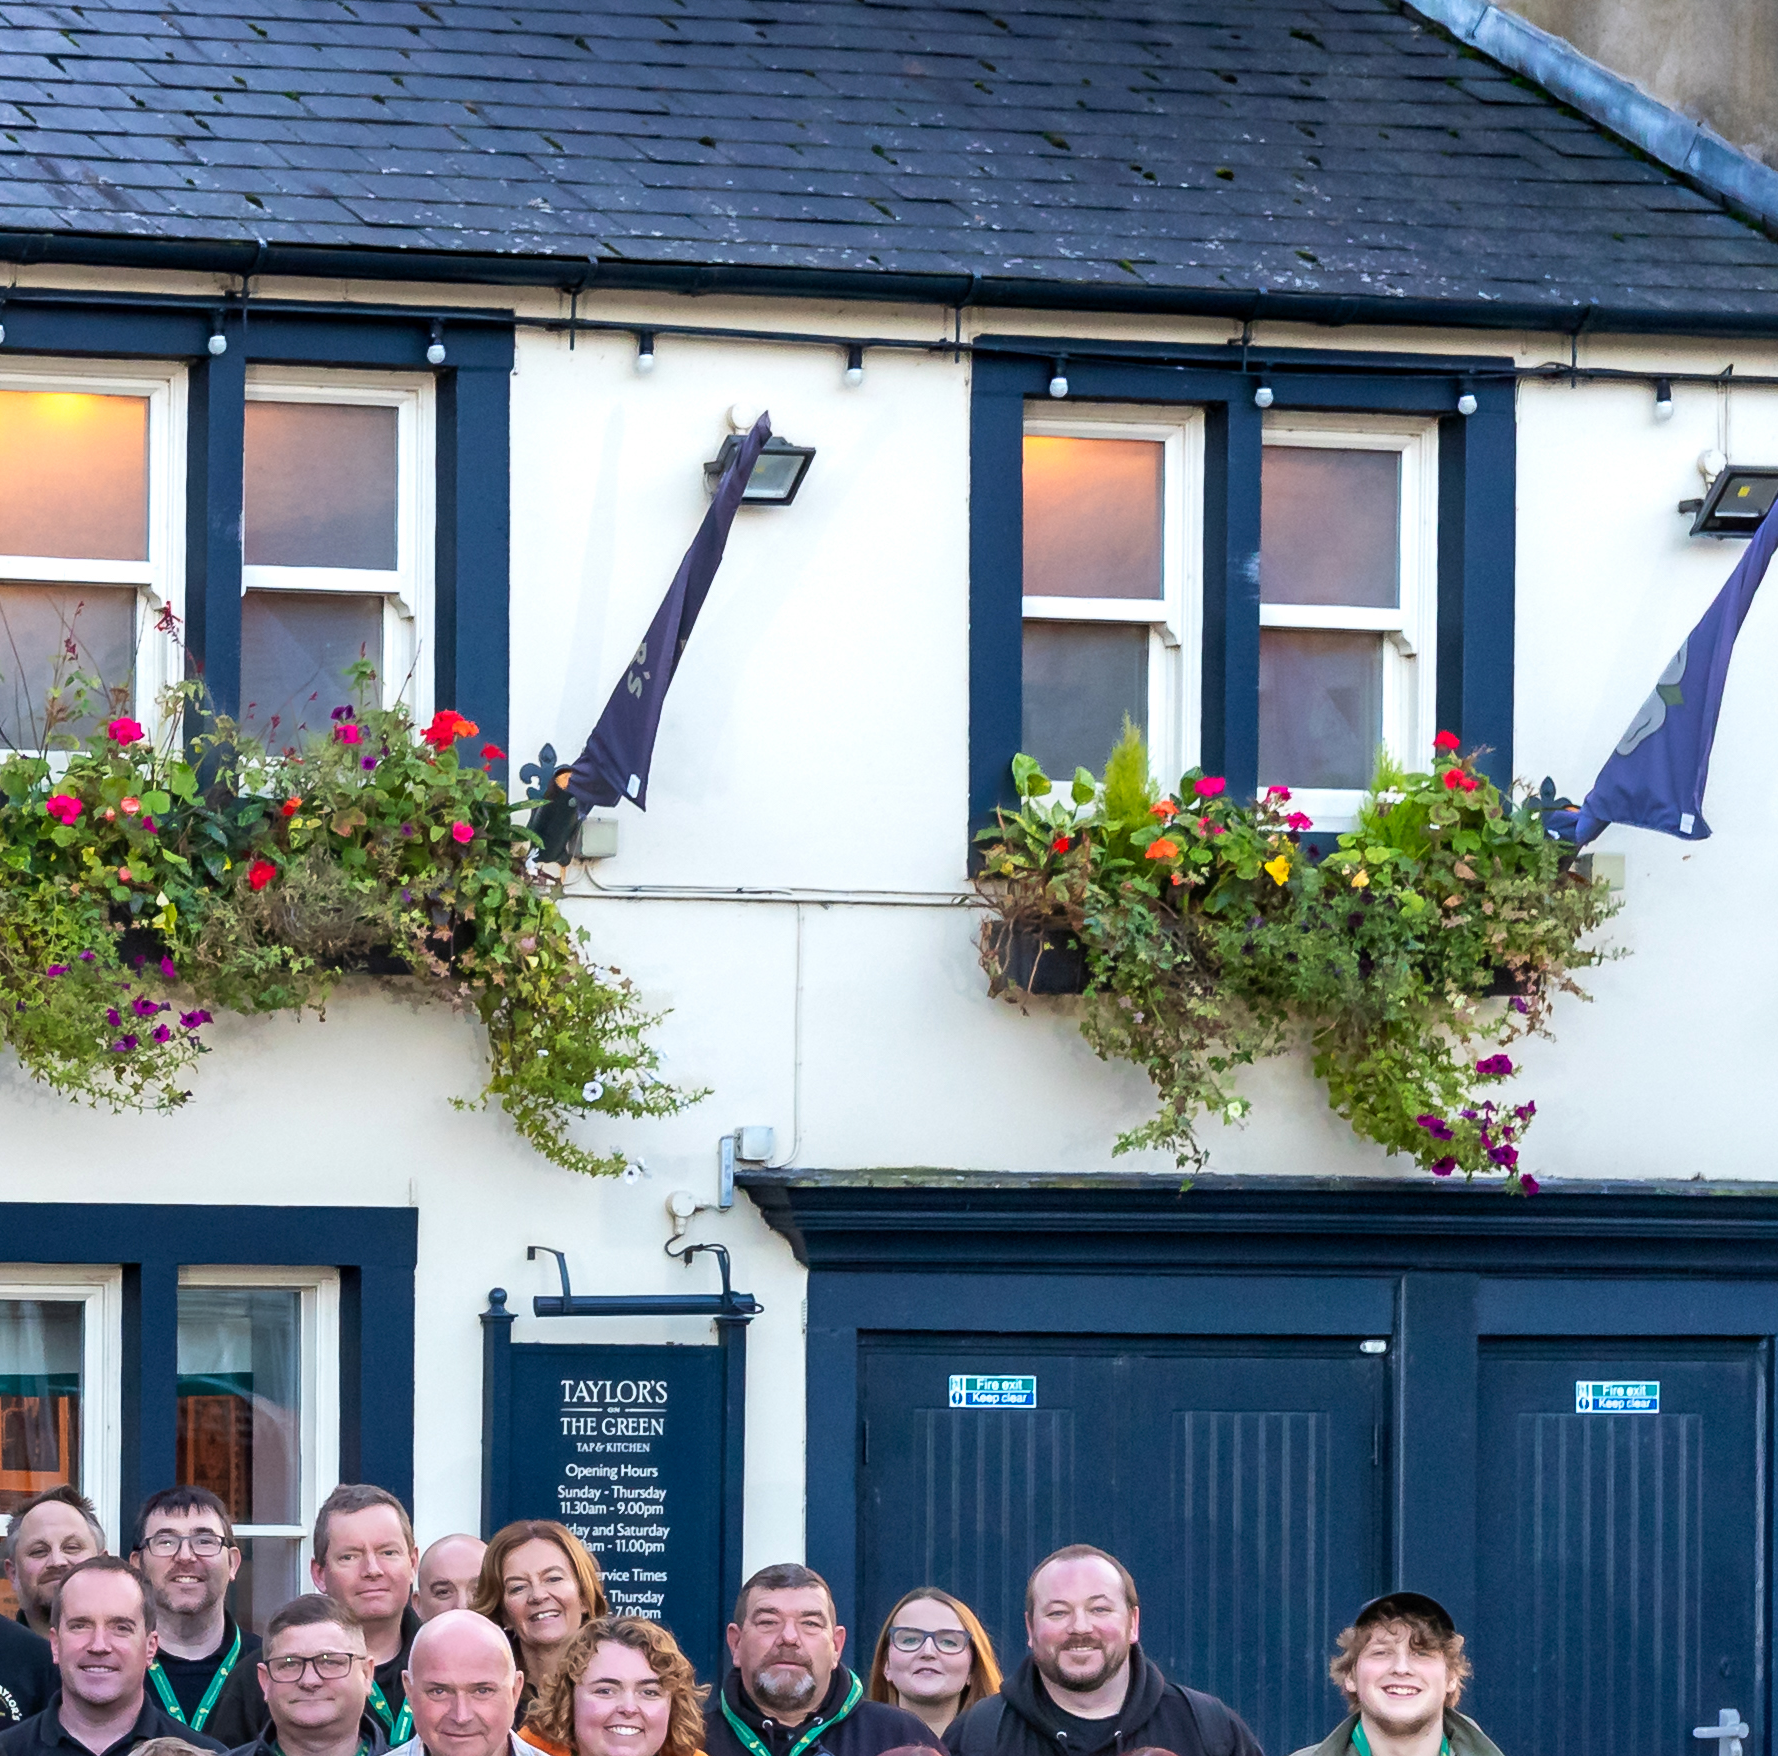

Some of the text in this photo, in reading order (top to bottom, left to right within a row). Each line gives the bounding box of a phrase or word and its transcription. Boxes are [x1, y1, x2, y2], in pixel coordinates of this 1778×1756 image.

[560, 1379, 668, 1404] TAYLOR'S
[976, 1378, 1023, 1391] Fire exit
[1602, 1384, 1647, 1396] Fire exit
[971, 1392, 1028, 1404] Keep clear
[1598, 1398, 1651, 1410] Keep clear
[560, 1417, 665, 1436] THE GREEN
[576, 1442, 596, 1452] TAP
[606, 1442, 651, 1453] KITCHEN
[565, 1463, 659, 1481] Opening Hours
[557, 1484, 602, 1501] Sunday
[611, 1484, 667, 1502] Thursday
[560, 1501, 607, 1515] 11.30am
[616, 1501, 664, 1518] 9.00pm
[592, 1523, 614, 1537] and
[616, 1522, 671, 1540] Saturday
[615, 1539, 665, 1556] 11.00pm
[631, 1568, 667, 1582] Times
[609, 1590, 665, 1606] Thursday
